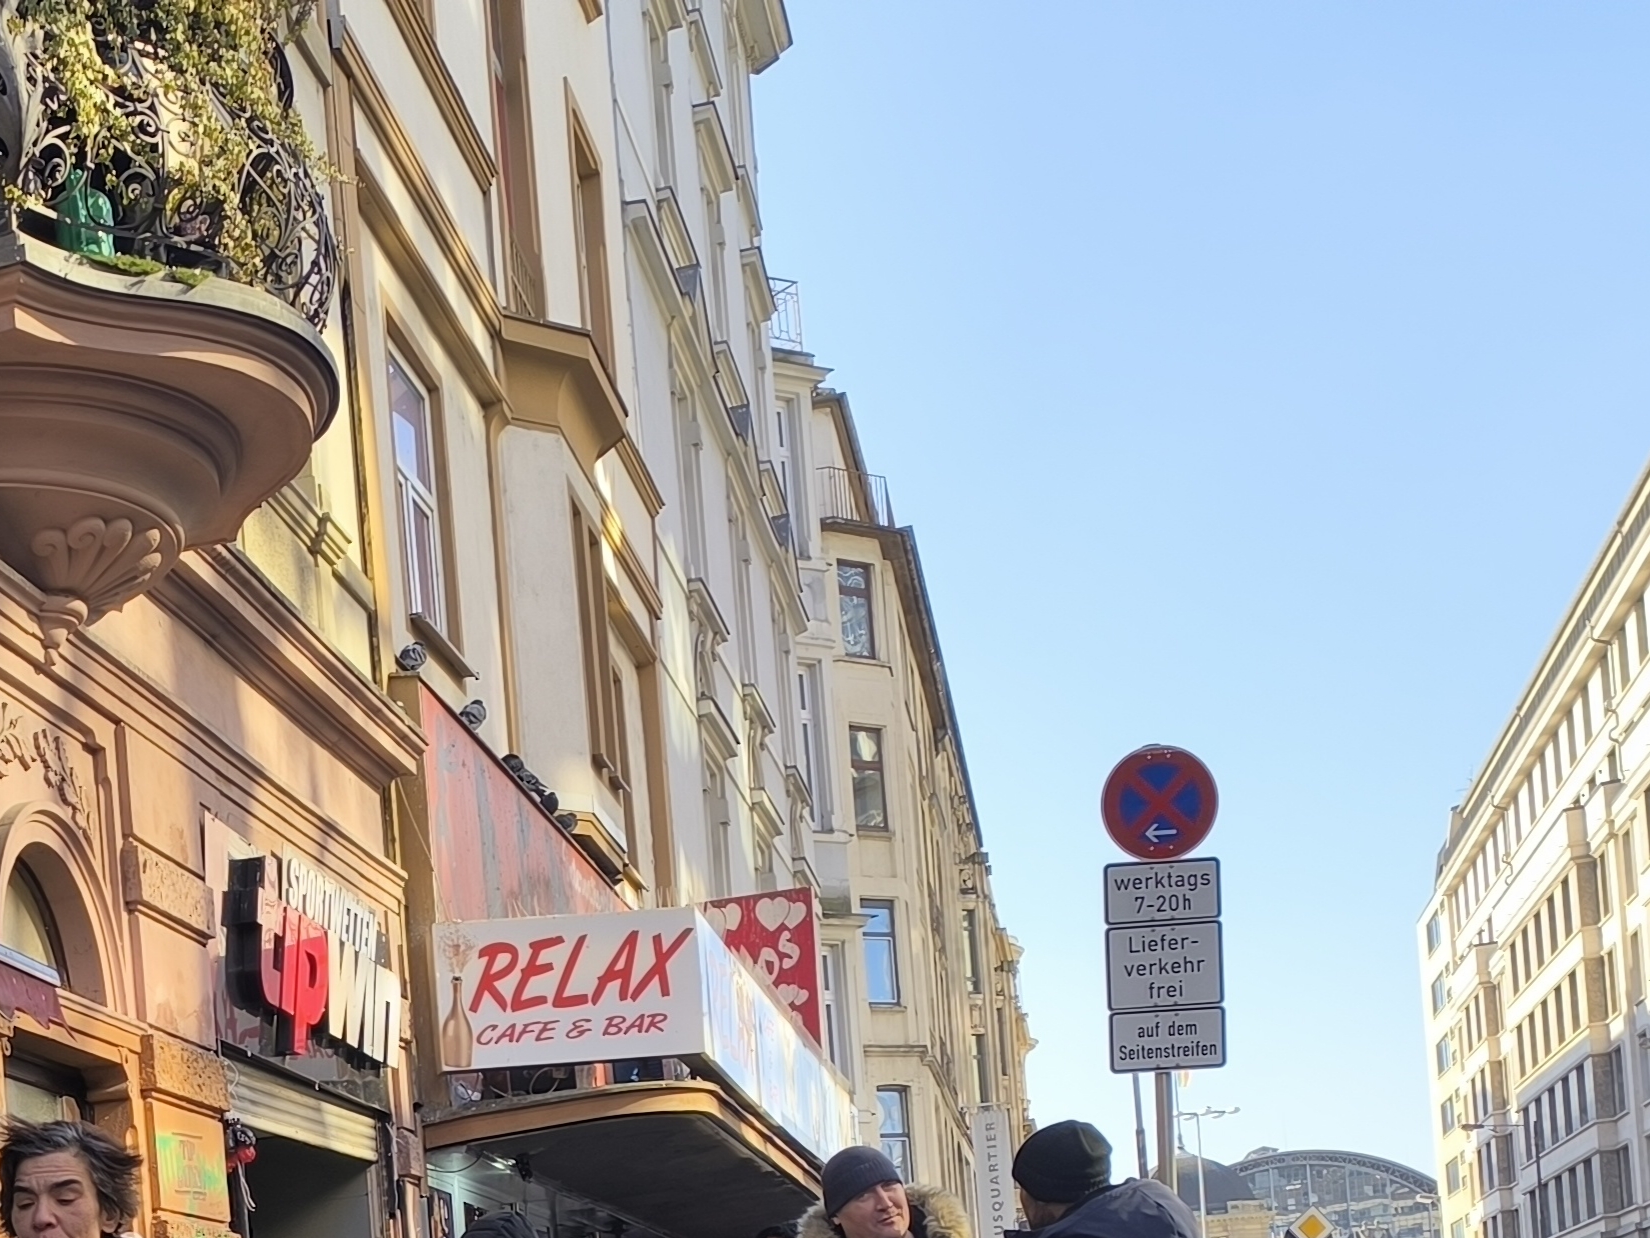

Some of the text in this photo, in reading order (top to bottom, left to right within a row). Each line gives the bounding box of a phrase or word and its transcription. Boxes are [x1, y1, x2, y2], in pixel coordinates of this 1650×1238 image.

[1114, 871, 1211, 892] werktags
[286, 857, 378, 963] SPORTWETTEN
[1128, 934, 1199, 953] Liefer-
[468, 926, 695, 1014] RELAX
[1124, 956, 1205, 977] verkehr
[1148, 980, 1183, 999] frei
[476, 1012, 669, 1046] CAFE & BAR
[1137, 1020, 1197, 1038] auf dem
[1119, 1041, 1217, 1061] Seitenstreifen
